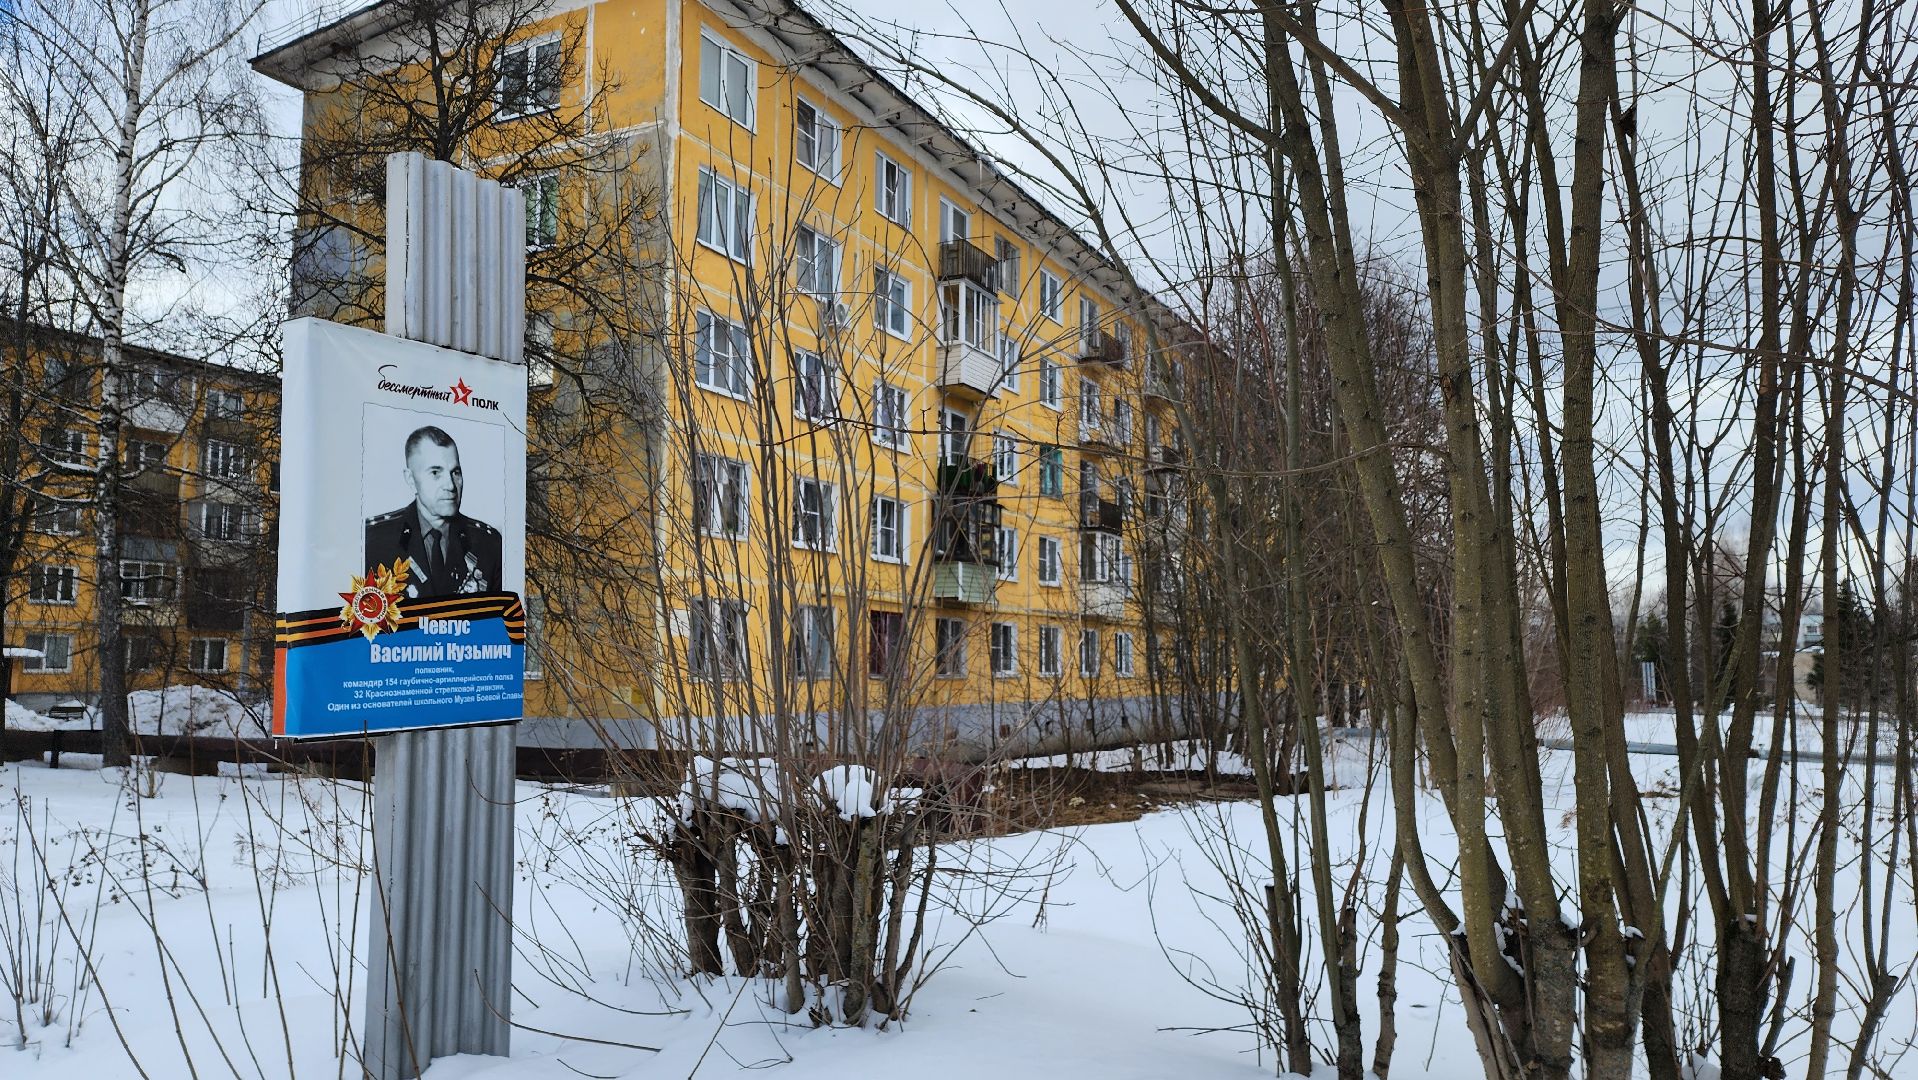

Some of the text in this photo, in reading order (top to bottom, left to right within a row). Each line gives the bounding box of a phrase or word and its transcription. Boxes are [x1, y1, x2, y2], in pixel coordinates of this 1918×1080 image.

[418, 615, 471, 637] Чевгус
[370, 641, 512, 663] Василий Кузьмич
[343, 680, 383, 689] командир
[385, 678, 398, 686] 154
[494, 673, 514, 681] полка
[327, 702, 350, 713] Один
[362, 697, 413, 709] основателей
[413, 696, 453, 706] школьного
[454, 694, 475, 704] Музея
[476, 692, 501, 702] Боевой
[353, 690, 364, 699] 32
[365, 686, 433, 700] Краснознаменной
[434, 684, 475, 694] стрелковой
